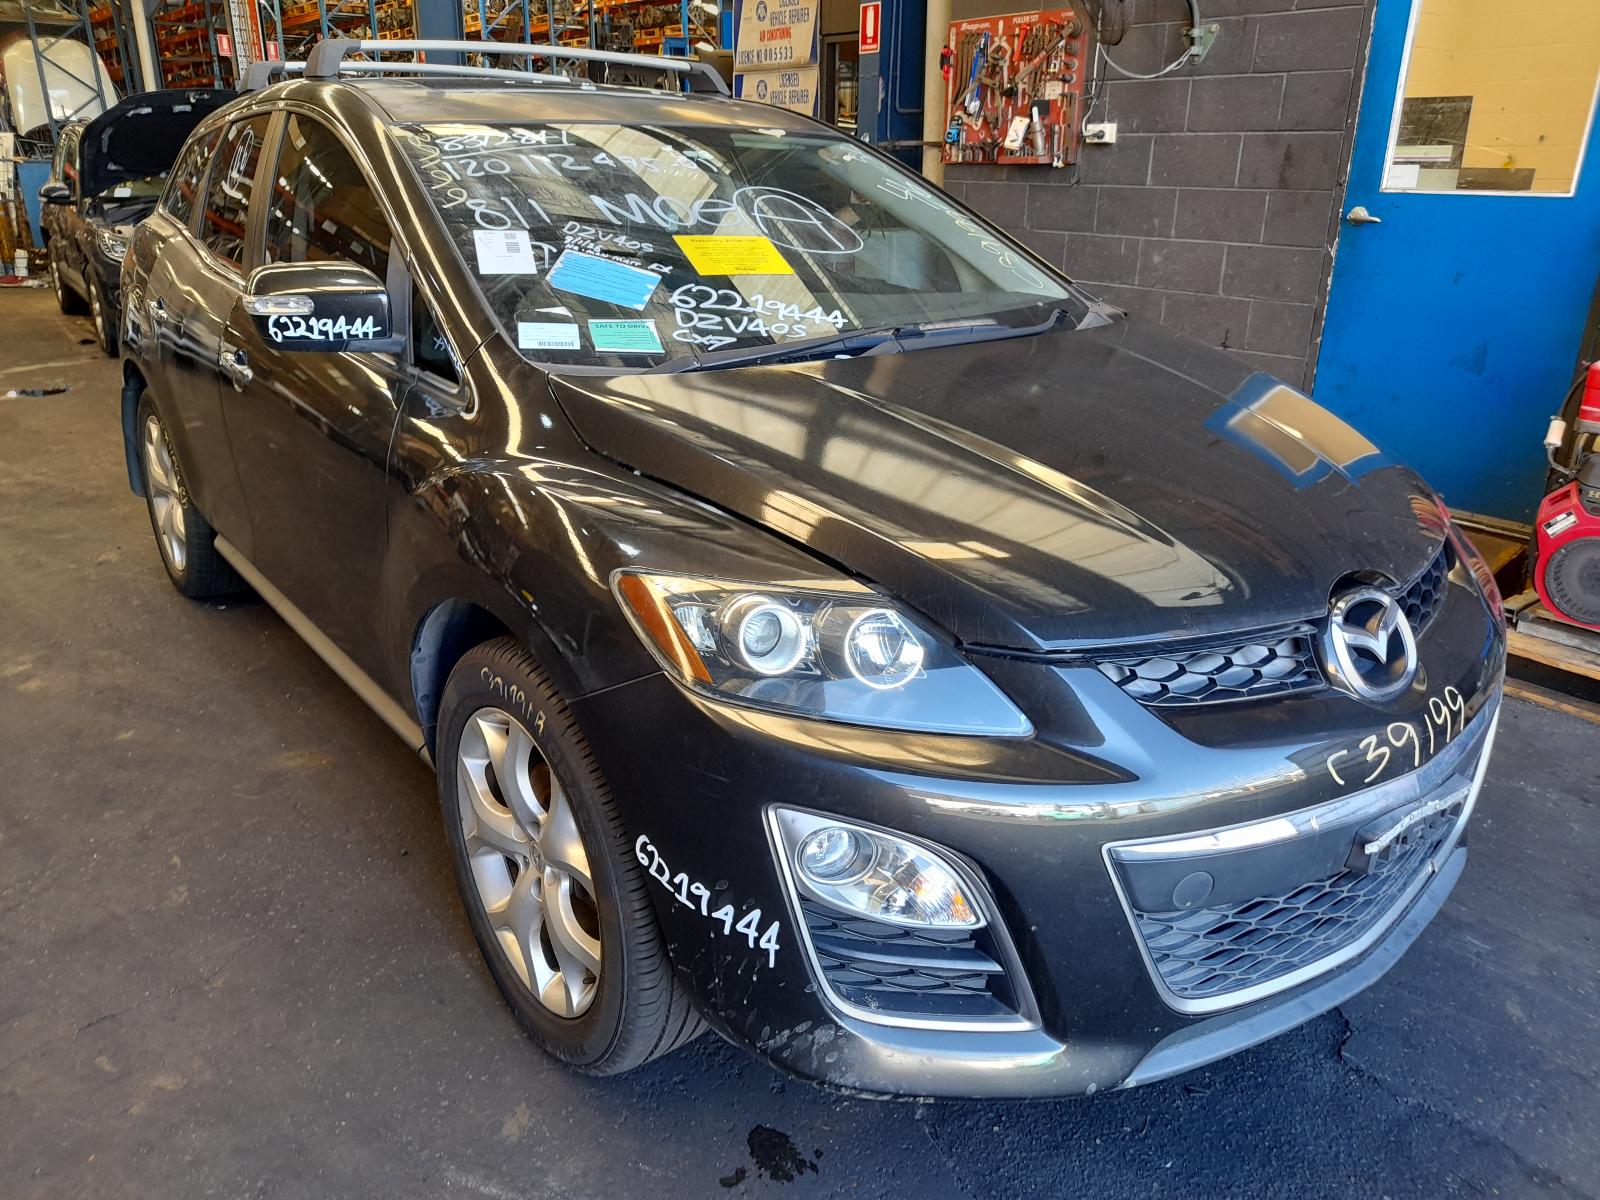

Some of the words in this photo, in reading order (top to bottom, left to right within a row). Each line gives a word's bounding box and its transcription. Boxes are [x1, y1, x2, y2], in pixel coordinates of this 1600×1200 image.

[770, 10, 787, 27] VEHICLE
[788, 7, 810, 24] REPAIRER
[763, 46, 793, 62] 005533
[778, 73, 800, 88] LICENSED
[770, 88, 787, 105] VEHICLE
[788, 89, 810, 105] REPAIRER
[268, 315, 382, 343] 62219444
